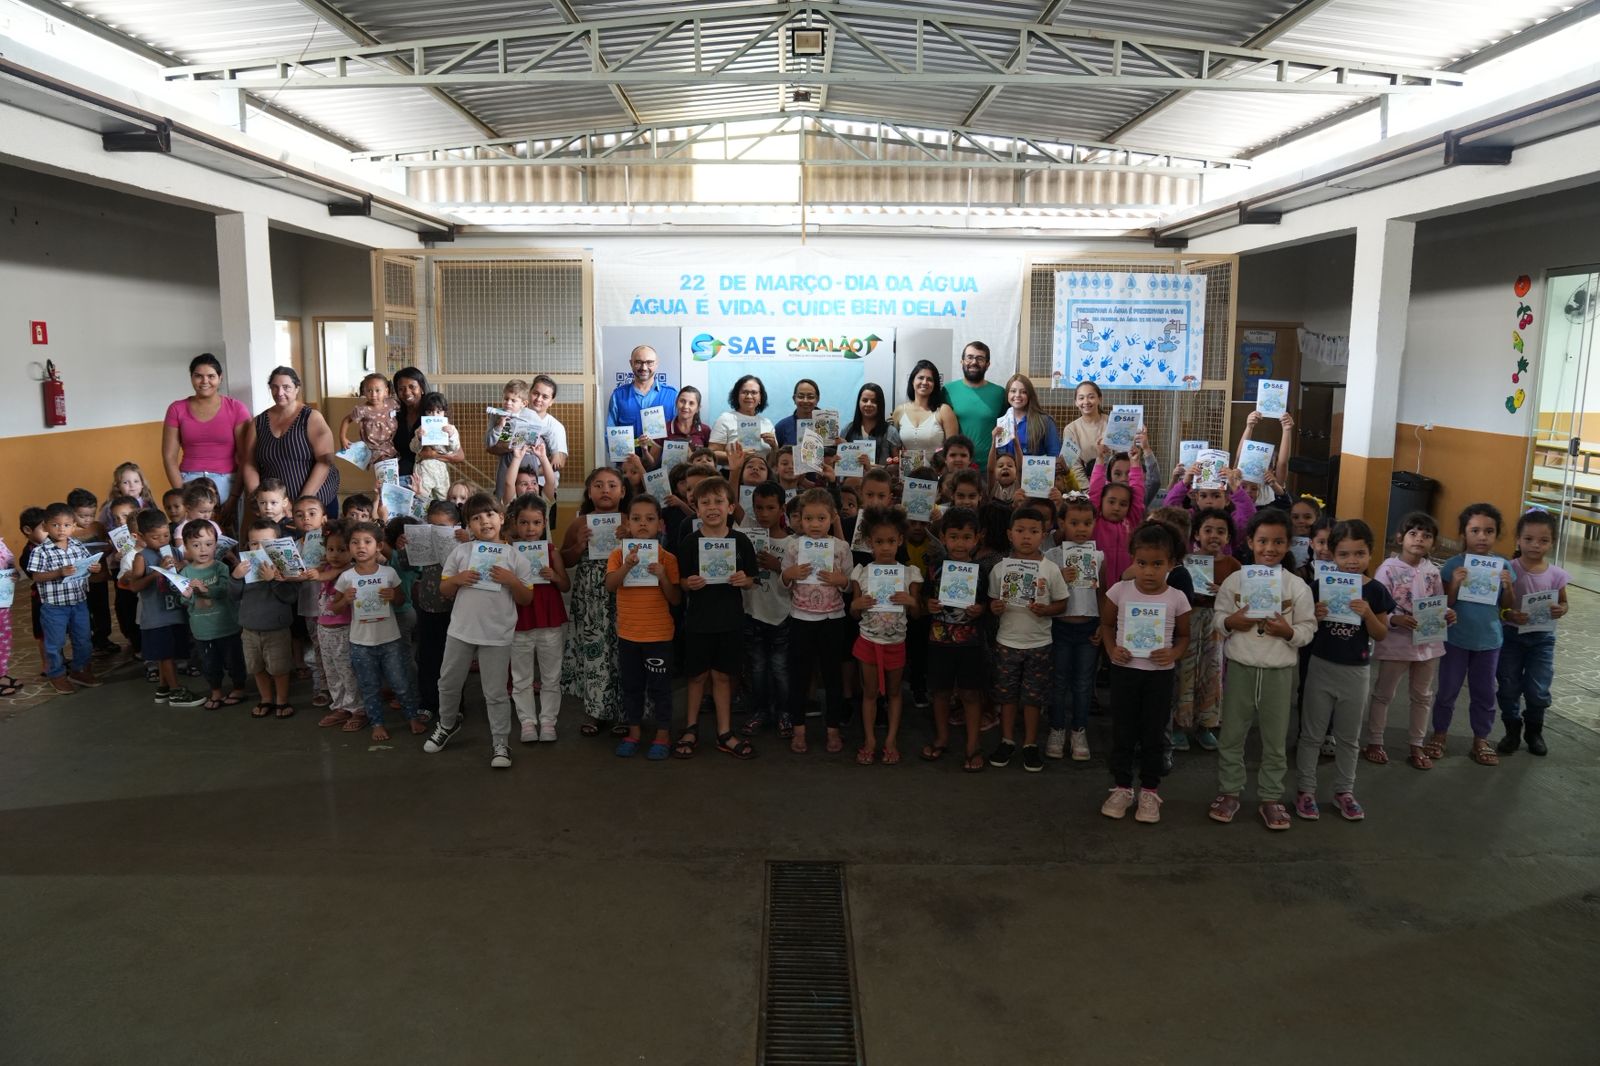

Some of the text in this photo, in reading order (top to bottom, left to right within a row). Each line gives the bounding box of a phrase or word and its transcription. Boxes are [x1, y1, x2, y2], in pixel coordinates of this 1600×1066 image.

[680, 274, 704, 290] 22
[720, 275, 746, 291] DE
[886, 275, 913, 291] DA
[919, 271, 978, 292] ÁGUA
[630, 294, 688, 315] ÁGUA
[696, 293, 709, 315] É
[782, 299, 846, 316] CUIDE
[851, 299, 896, 315] BEM
[902, 300, 967, 317] DELA!
[728, 336, 776, 354] SAE
[786, 335, 863, 352] CATALÃO
[1331, 628, 1353, 636] COOL
